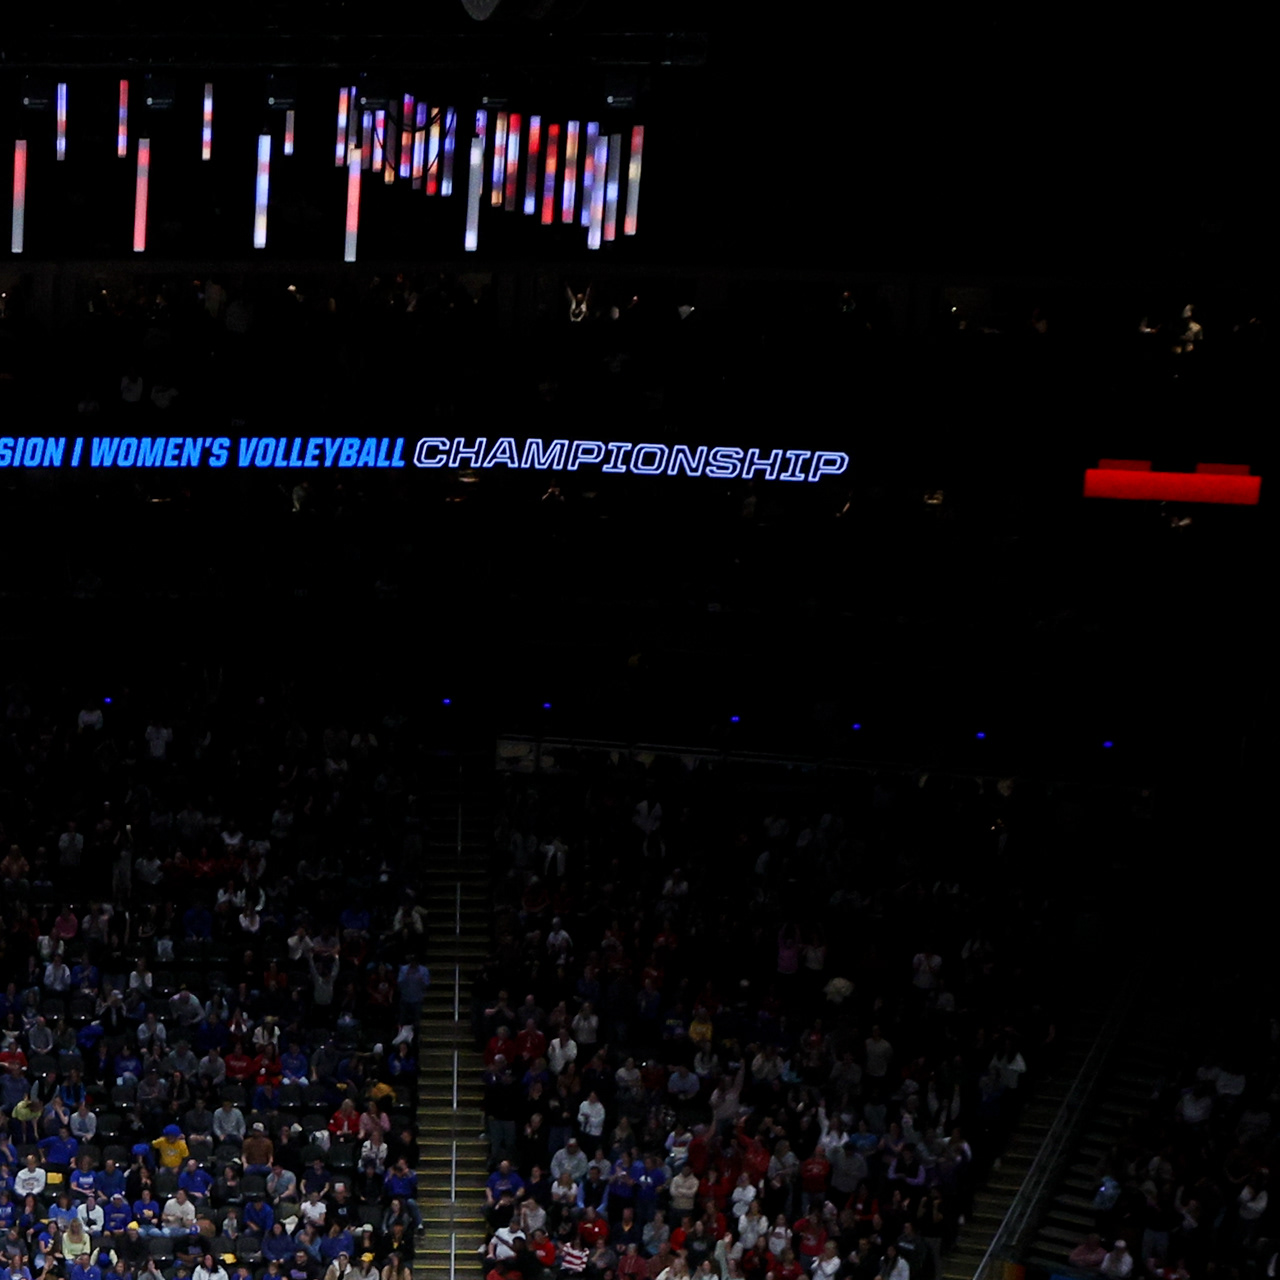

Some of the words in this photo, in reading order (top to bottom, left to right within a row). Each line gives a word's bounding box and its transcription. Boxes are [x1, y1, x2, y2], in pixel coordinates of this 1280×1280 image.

[91, 437, 230, 468] WOMEN'S
[239, 436, 407, 468] VOLLEYBALL
[413, 436, 849, 483] CHAMPIONSHIP
